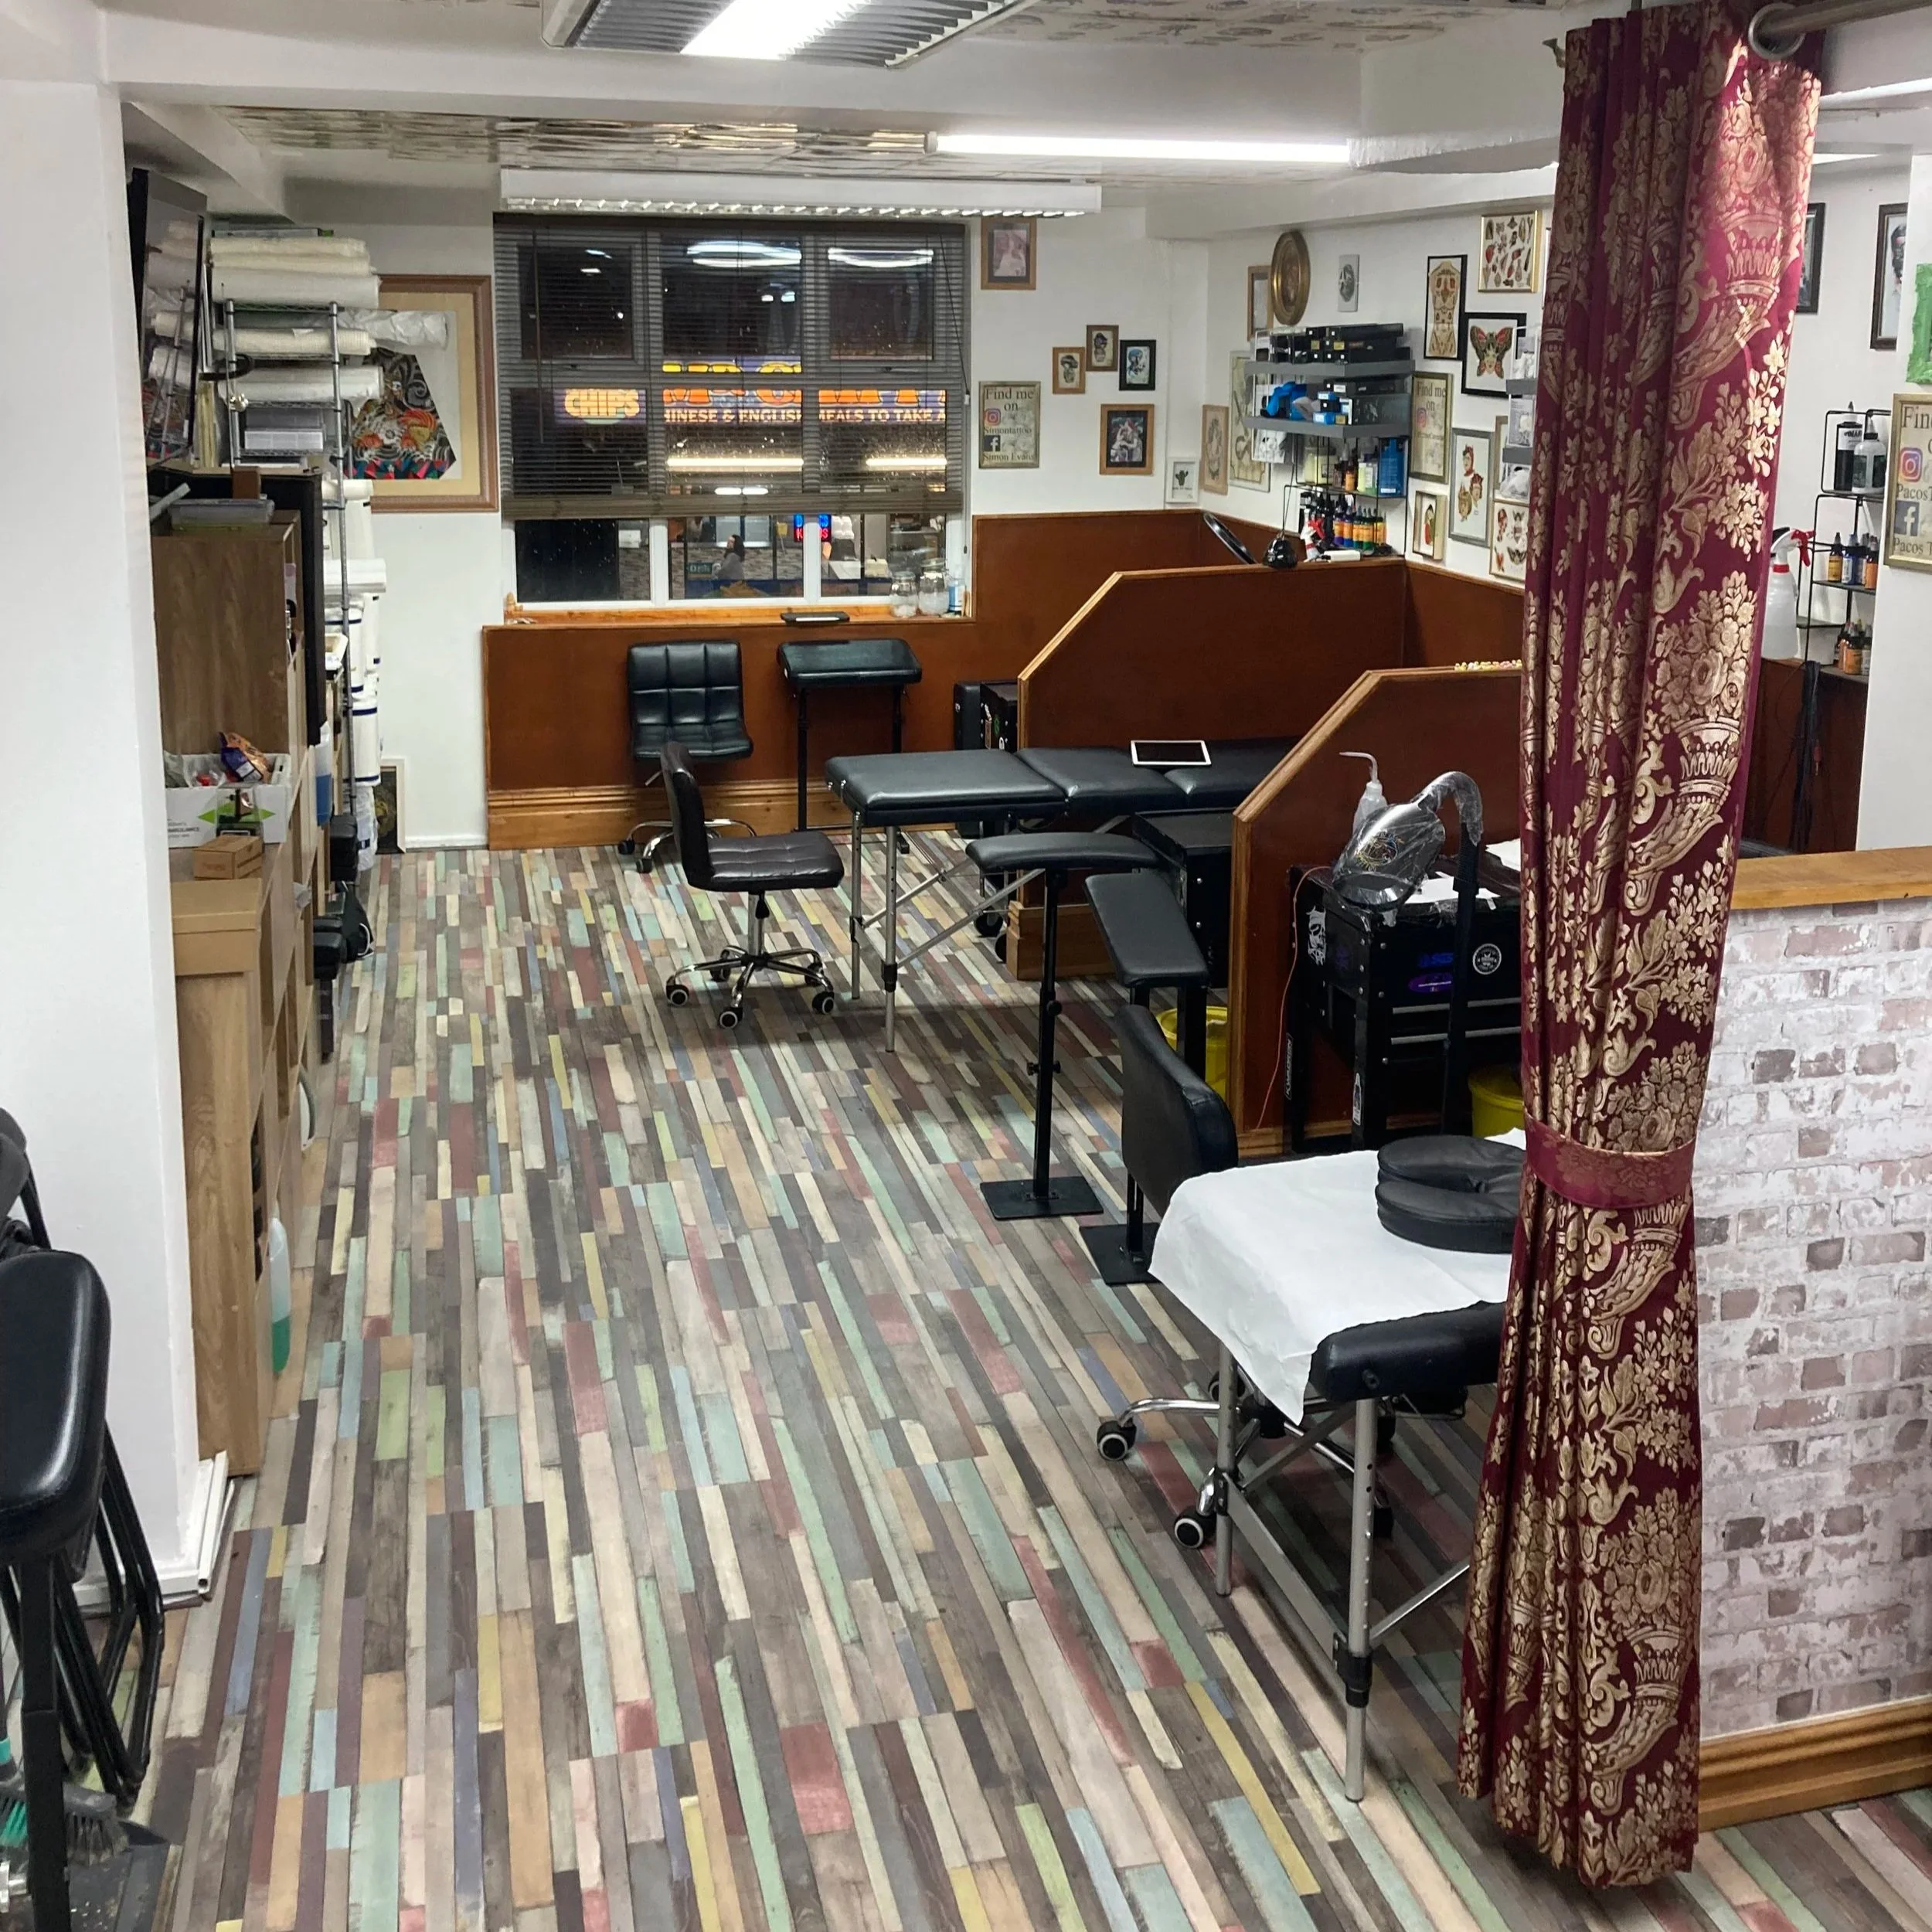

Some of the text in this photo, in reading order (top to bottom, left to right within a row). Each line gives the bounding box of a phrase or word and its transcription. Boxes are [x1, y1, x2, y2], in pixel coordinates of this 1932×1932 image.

[985, 388, 1034, 400] Find me
[1417, 381, 1434, 397] Find
[565, 389, 640, 417] CHIPS
[1004, 402, 1019, 411] on
[664, 409, 717, 422] HINESE
[721, 409, 735, 422] &
[867, 409, 889, 422] TO
[893, 409, 932, 422] TAKE
[1902, 406, 1932, 429] Fin
[983, 452, 1009, 461] Simon
[1893, 537, 1923, 556] Pacos
